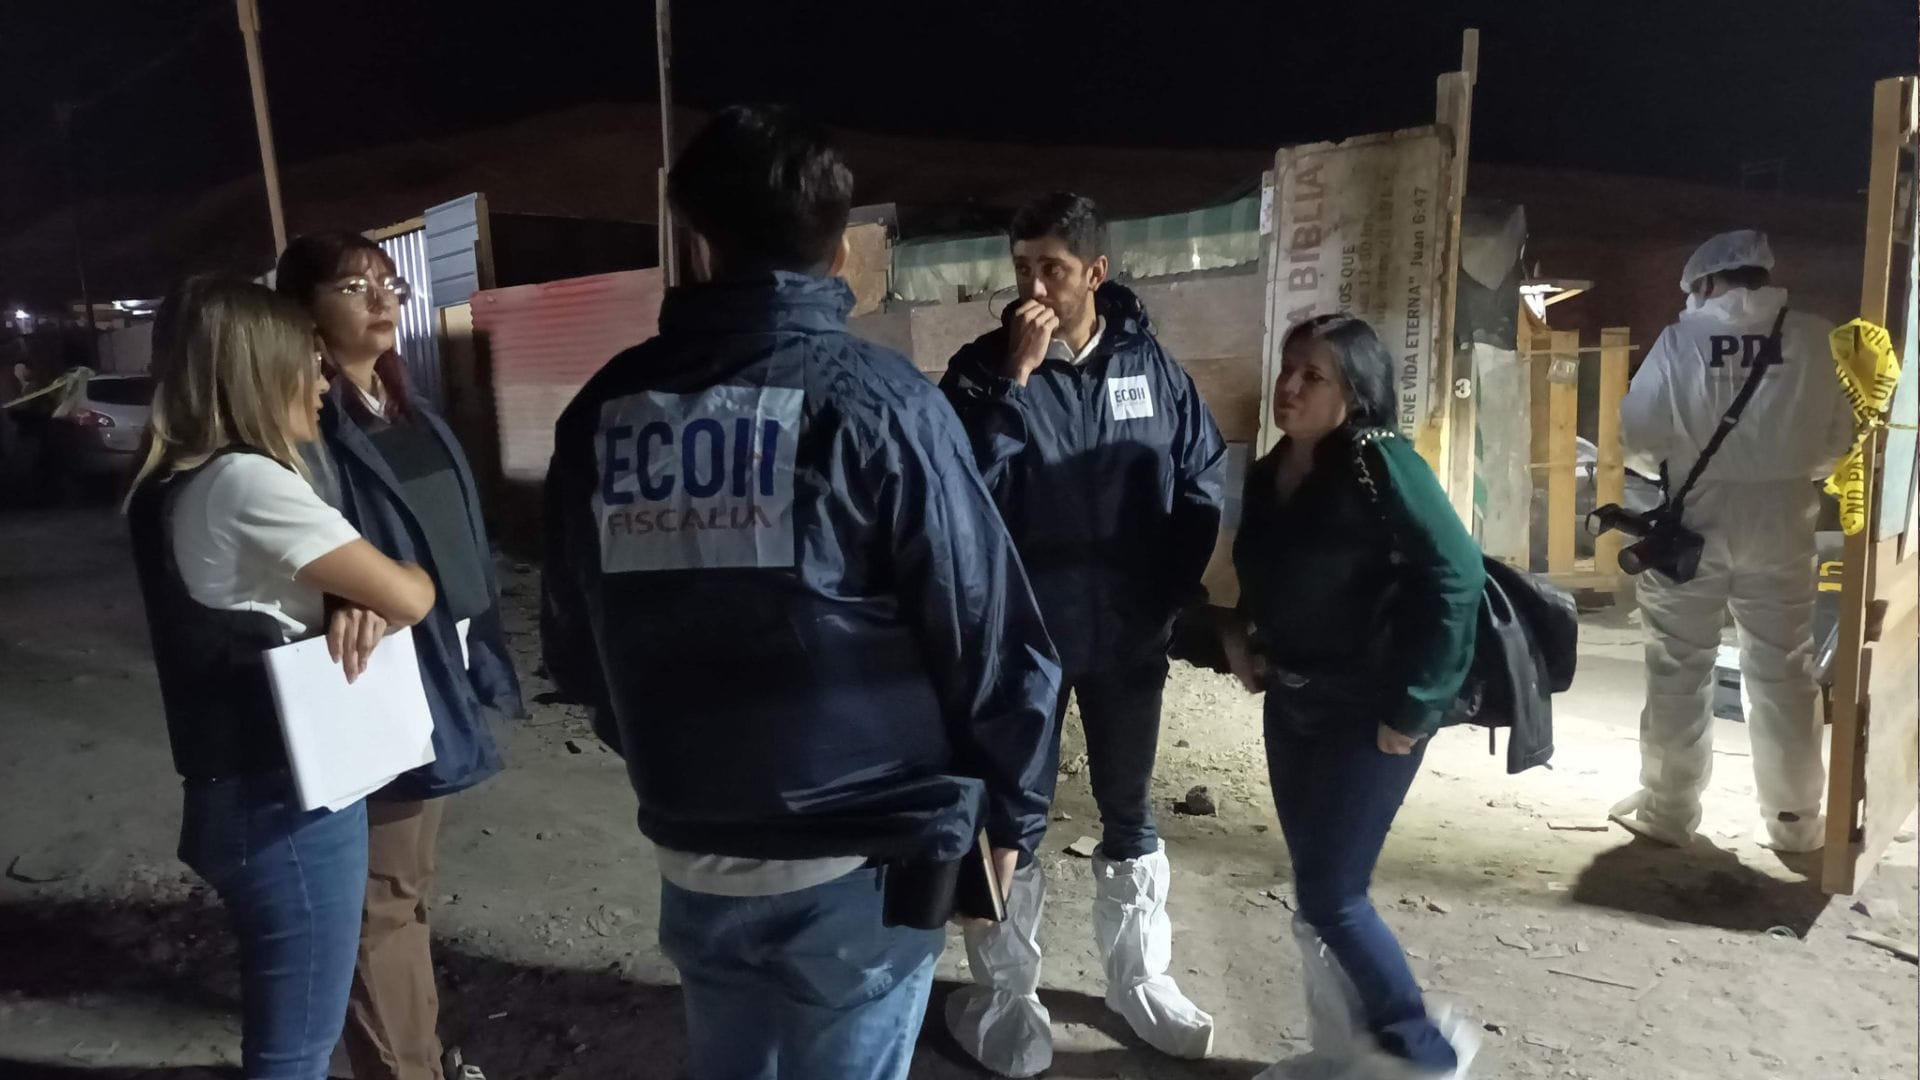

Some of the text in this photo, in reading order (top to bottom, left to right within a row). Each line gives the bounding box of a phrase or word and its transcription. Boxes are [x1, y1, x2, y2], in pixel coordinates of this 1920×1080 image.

[1412, 186, 1428, 225] 6:47
[1288, 163, 1326, 292] BIBLIA
[1340, 244, 1356, 279] QUE
